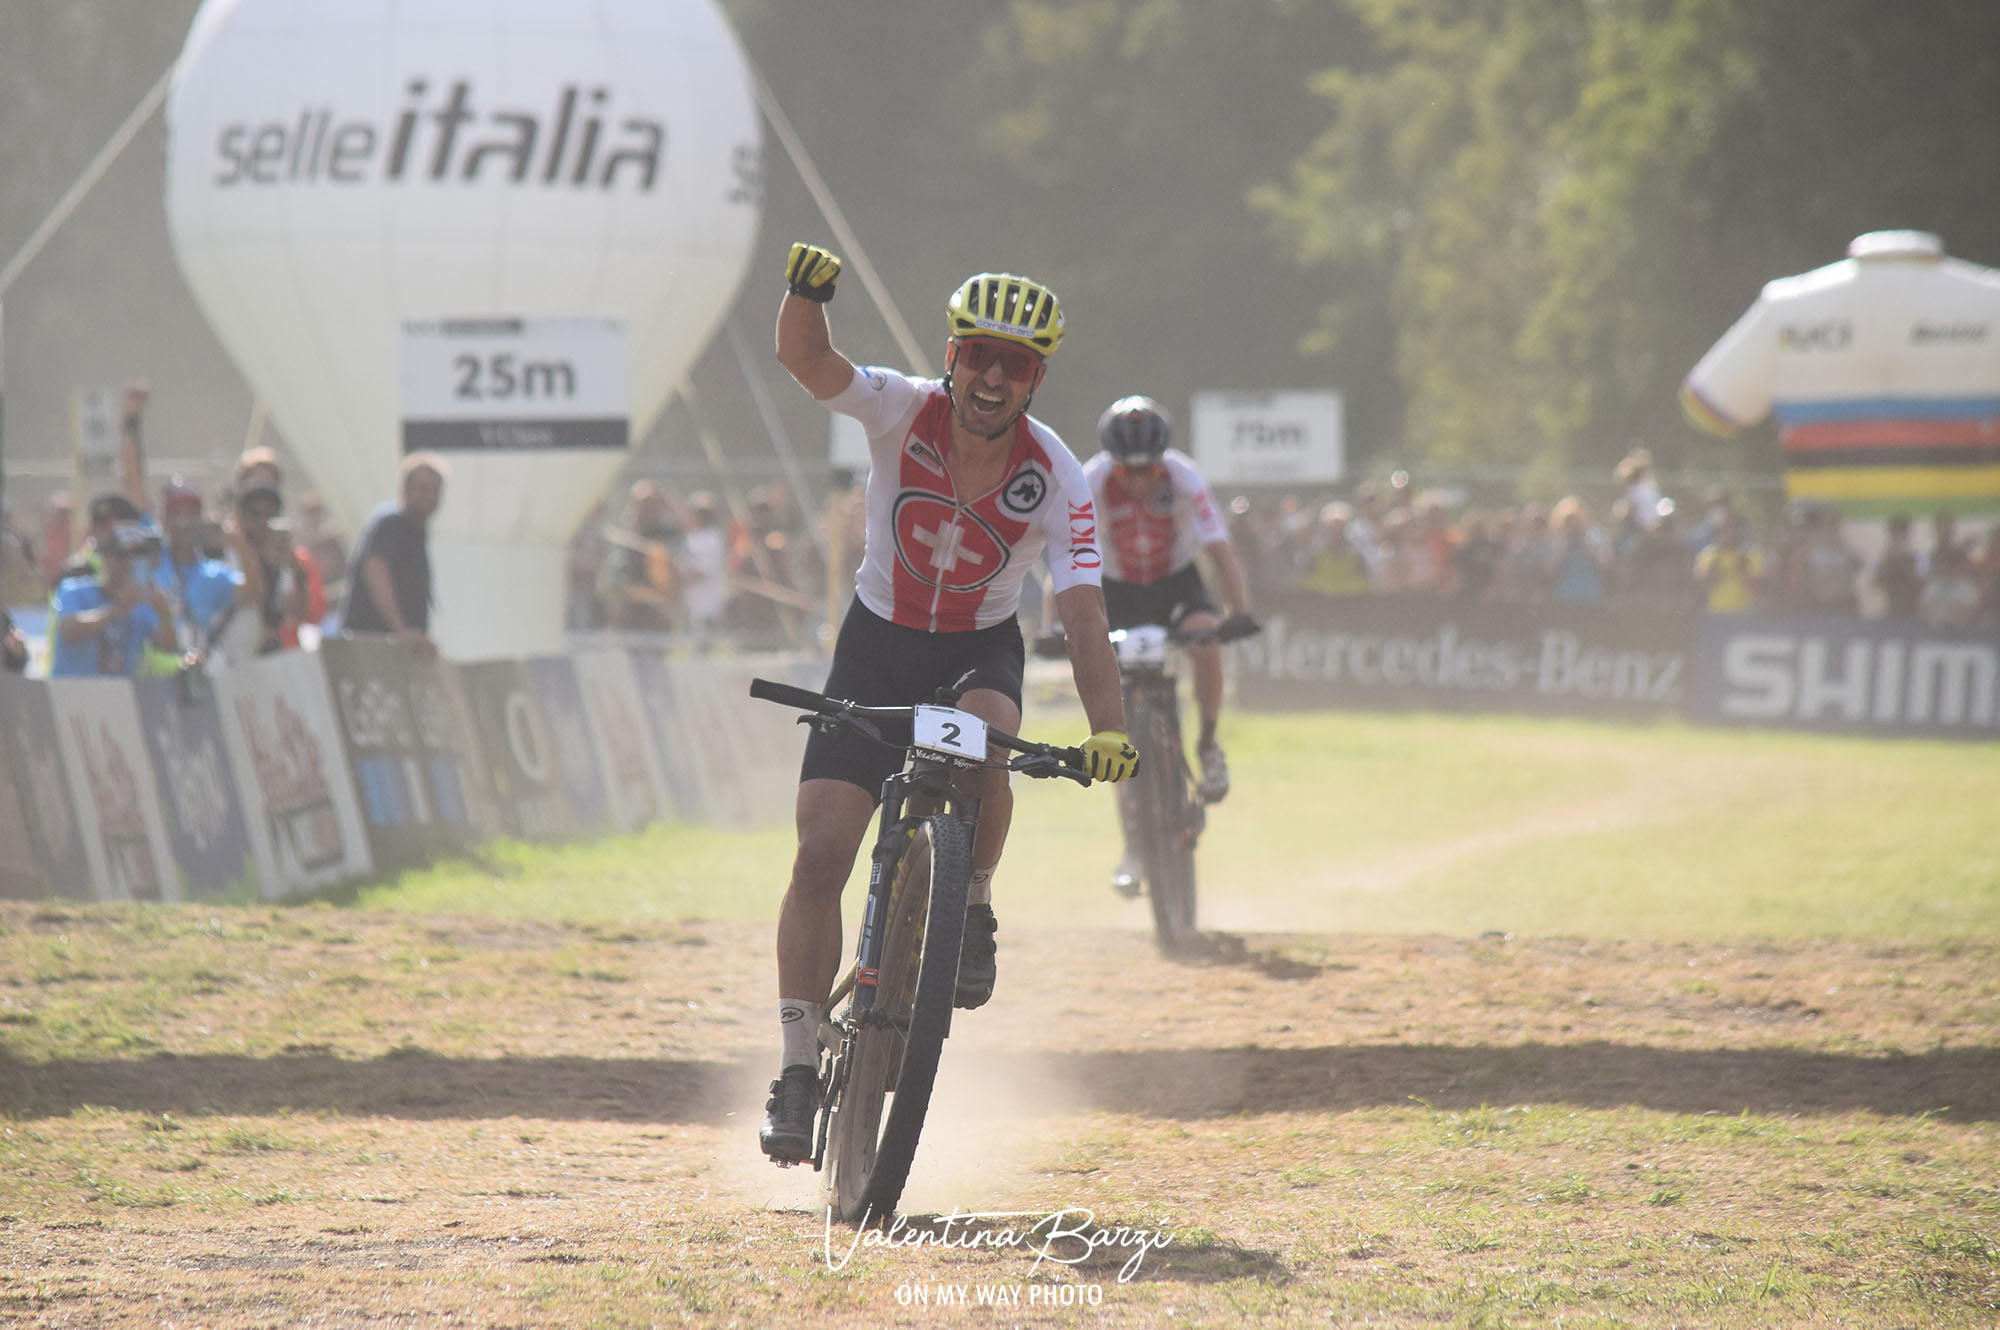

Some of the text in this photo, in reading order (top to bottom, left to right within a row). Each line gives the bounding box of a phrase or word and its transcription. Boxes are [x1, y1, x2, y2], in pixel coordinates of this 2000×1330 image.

[454, 353, 576, 399] 25m
[1226, 616, 1685, 701] Mercedes-Benz
[941, 722, 961, 747] 2
